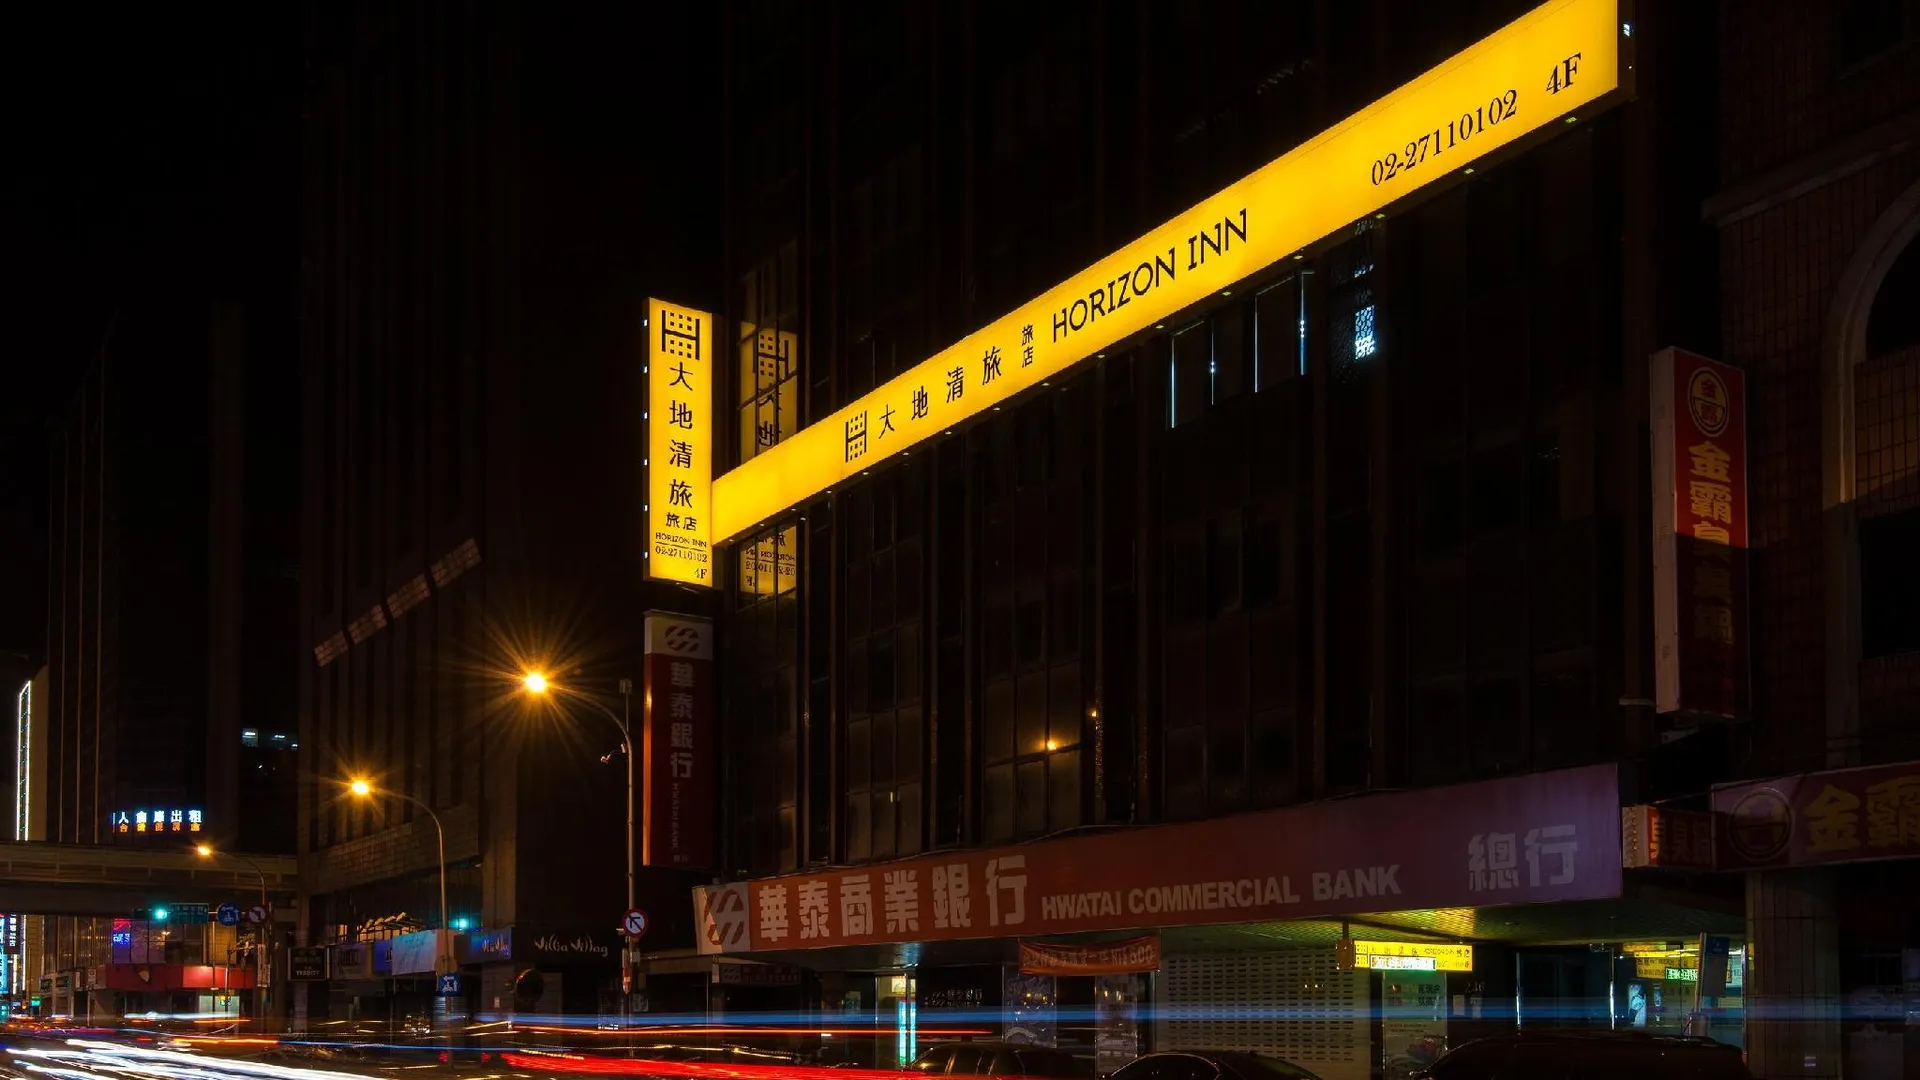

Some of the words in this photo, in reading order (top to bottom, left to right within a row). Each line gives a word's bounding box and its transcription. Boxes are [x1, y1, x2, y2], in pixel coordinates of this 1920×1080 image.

[1371, 89, 1518, 186] 02-27110102
[1546, 53, 1582, 95] 4F
[1053, 247, 1176, 343] HORIZON
[1188, 208, 1248, 272] INN
[1021, 324, 1034, 369] 旅店
[878, 346, 1002, 440] 大地清旅
[668, 361, 694, 510] 大地清旅
[655, 532, 690, 545] HORIZON
[655, 545, 709, 563] 02-27110102
[665, 512, 697, 532] 旅店
[693, 567, 708, 579] 4F
[670, 660, 695, 779] 華泰銀行
[1041, 892, 1122, 921] HWATAI
[1127, 874, 1300, 915] COMMERCIAL
[1311, 864, 1402, 901] BANK
[1467, 823, 1579, 893] 總行
[758, 854, 1029, 943] 華泰商業銀行
